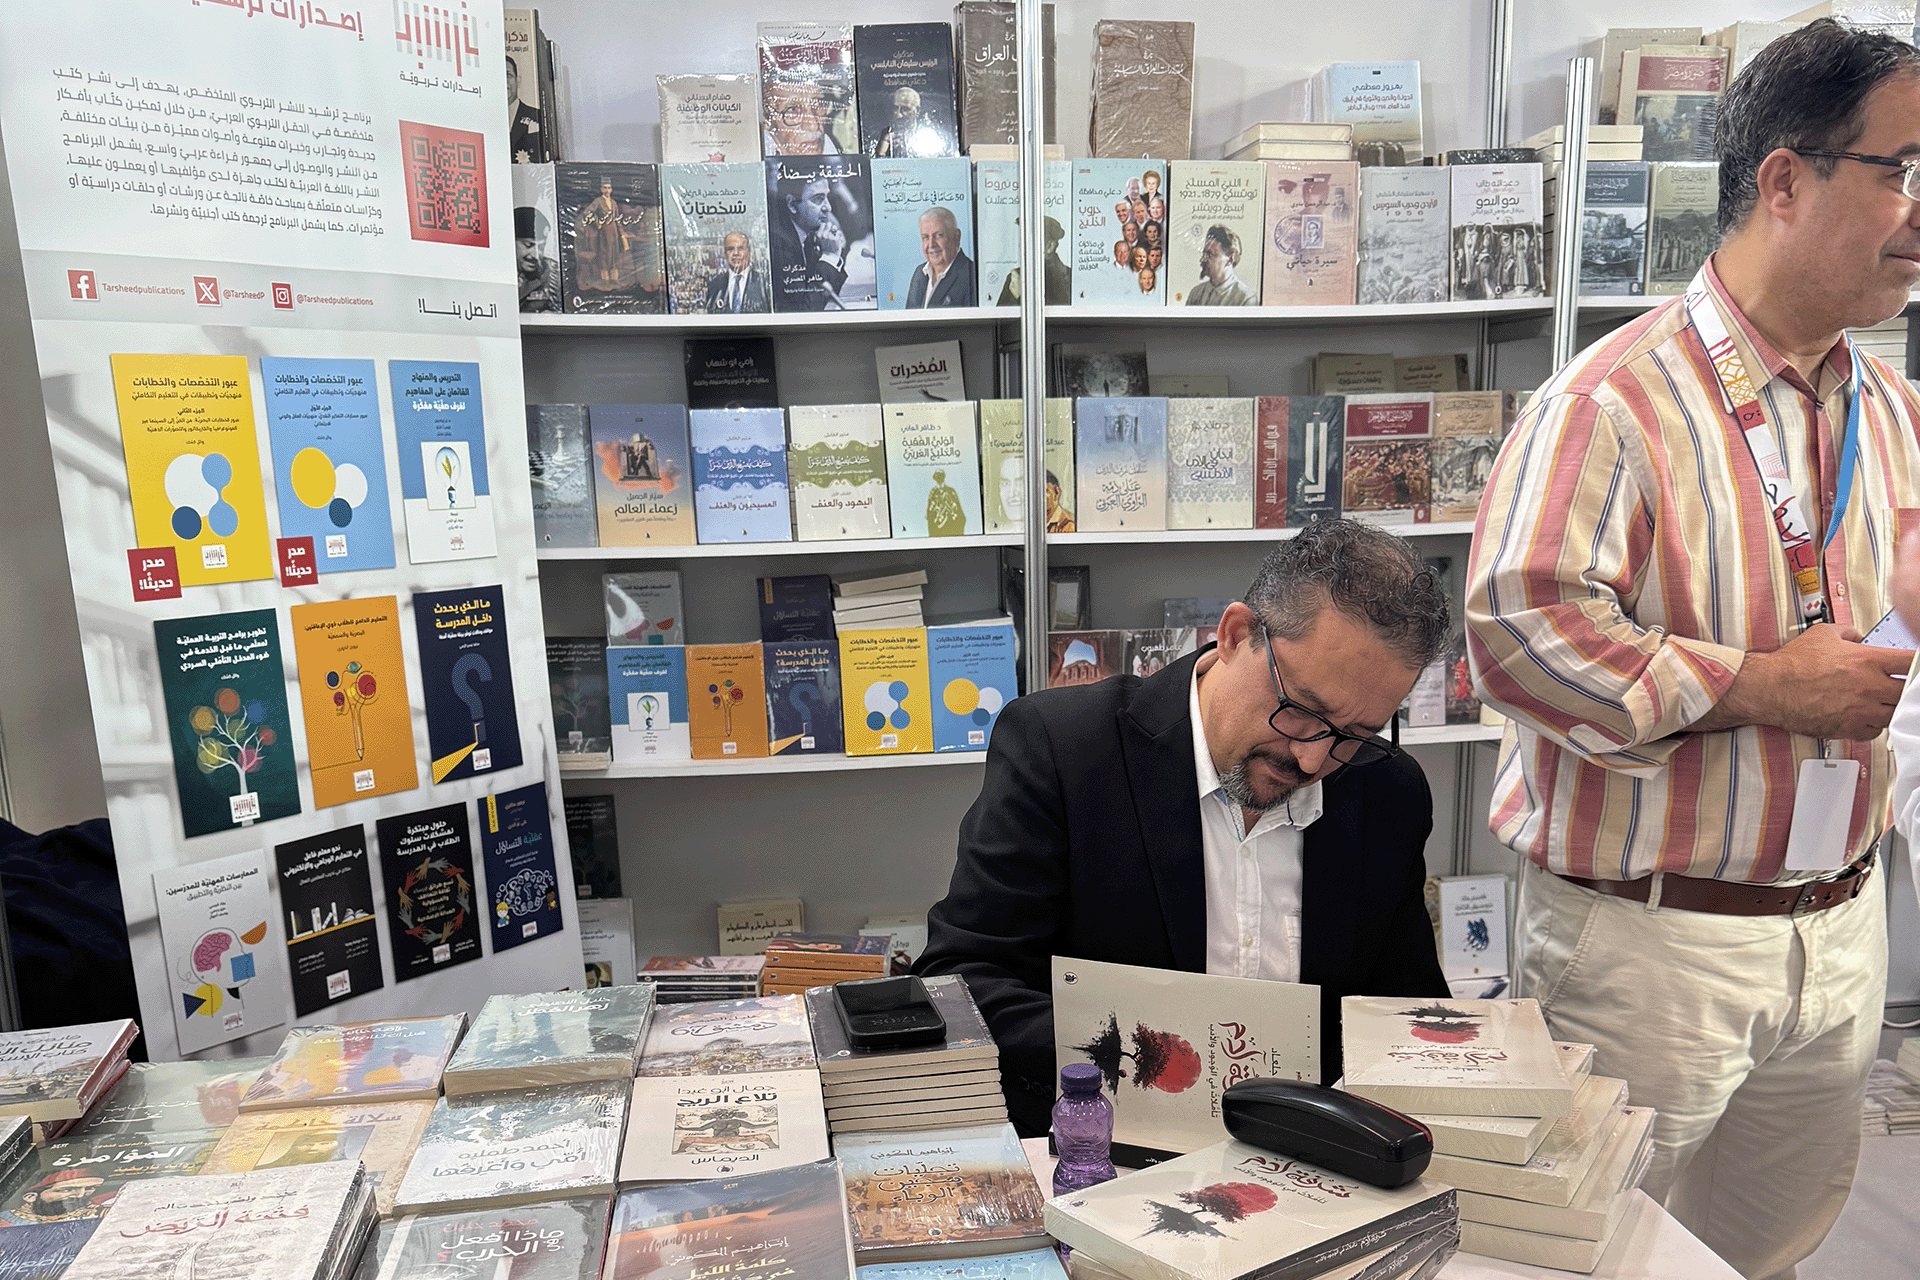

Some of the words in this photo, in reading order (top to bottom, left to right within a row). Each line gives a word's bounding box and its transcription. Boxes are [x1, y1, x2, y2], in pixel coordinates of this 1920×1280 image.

[505, 31, 528, 43] مذكرا
[975, 44, 1009, 67] العراق
[53, 68, 82, 79] كتب
[88, 71, 111, 83] نشر
[116, 77, 139, 91] إلى
[142, 80, 179, 95] يهدف
[142, 122, 161, 133] من
[63, 134, 106, 148] البرنامج
[109, 137, 142, 153] يشمل
[274, 160, 291, 172] إلى
[337, 166, 360, 178] النشر
[363, 169, 377, 180] من
[819, 163, 861, 182] الحقيقة
[1079, 206, 1101, 214] حروب
[302, 219, 326, 231] يشمل
[328, 222, 343, 231] كما
[1079, 216, 1105, 227] الخليج
[783, 265, 806, 273] مذكرات
[101, 283, 185, 296] Tarsheedpublications
[223, 289, 265, 300] @TarsheedP
[296, 293, 374, 306] @Tarsheedpublications
[464, 303, 498, 320] اتصل
[846, 497, 872, 508] اليهود
[615, 503, 646, 516] العالم
[649, 505, 678, 516] زعماء
[288, 547, 305, 559] صدر
[143, 557, 165, 571] صدر
[434, 602, 459, 614] يحدث
[460, 601, 478, 612] الذي
[479, 599, 490, 608] ما
[472, 614, 492, 624] داخل
[228, 631, 246, 640] برامج
[248, 627, 266, 637] تطوير
[180, 649, 193, 660] في
[798, 648, 817, 657] الذي
[671, 1025, 707, 1035] 67
[677, 1095, 728, 1107] الريح
[735, 1093, 777, 1105] تلاع
[52, 1147, 185, 1167] المؤامرة
[692, 1155, 759, 1165] الديماس
[515, 1229, 564, 1241] ماذا
